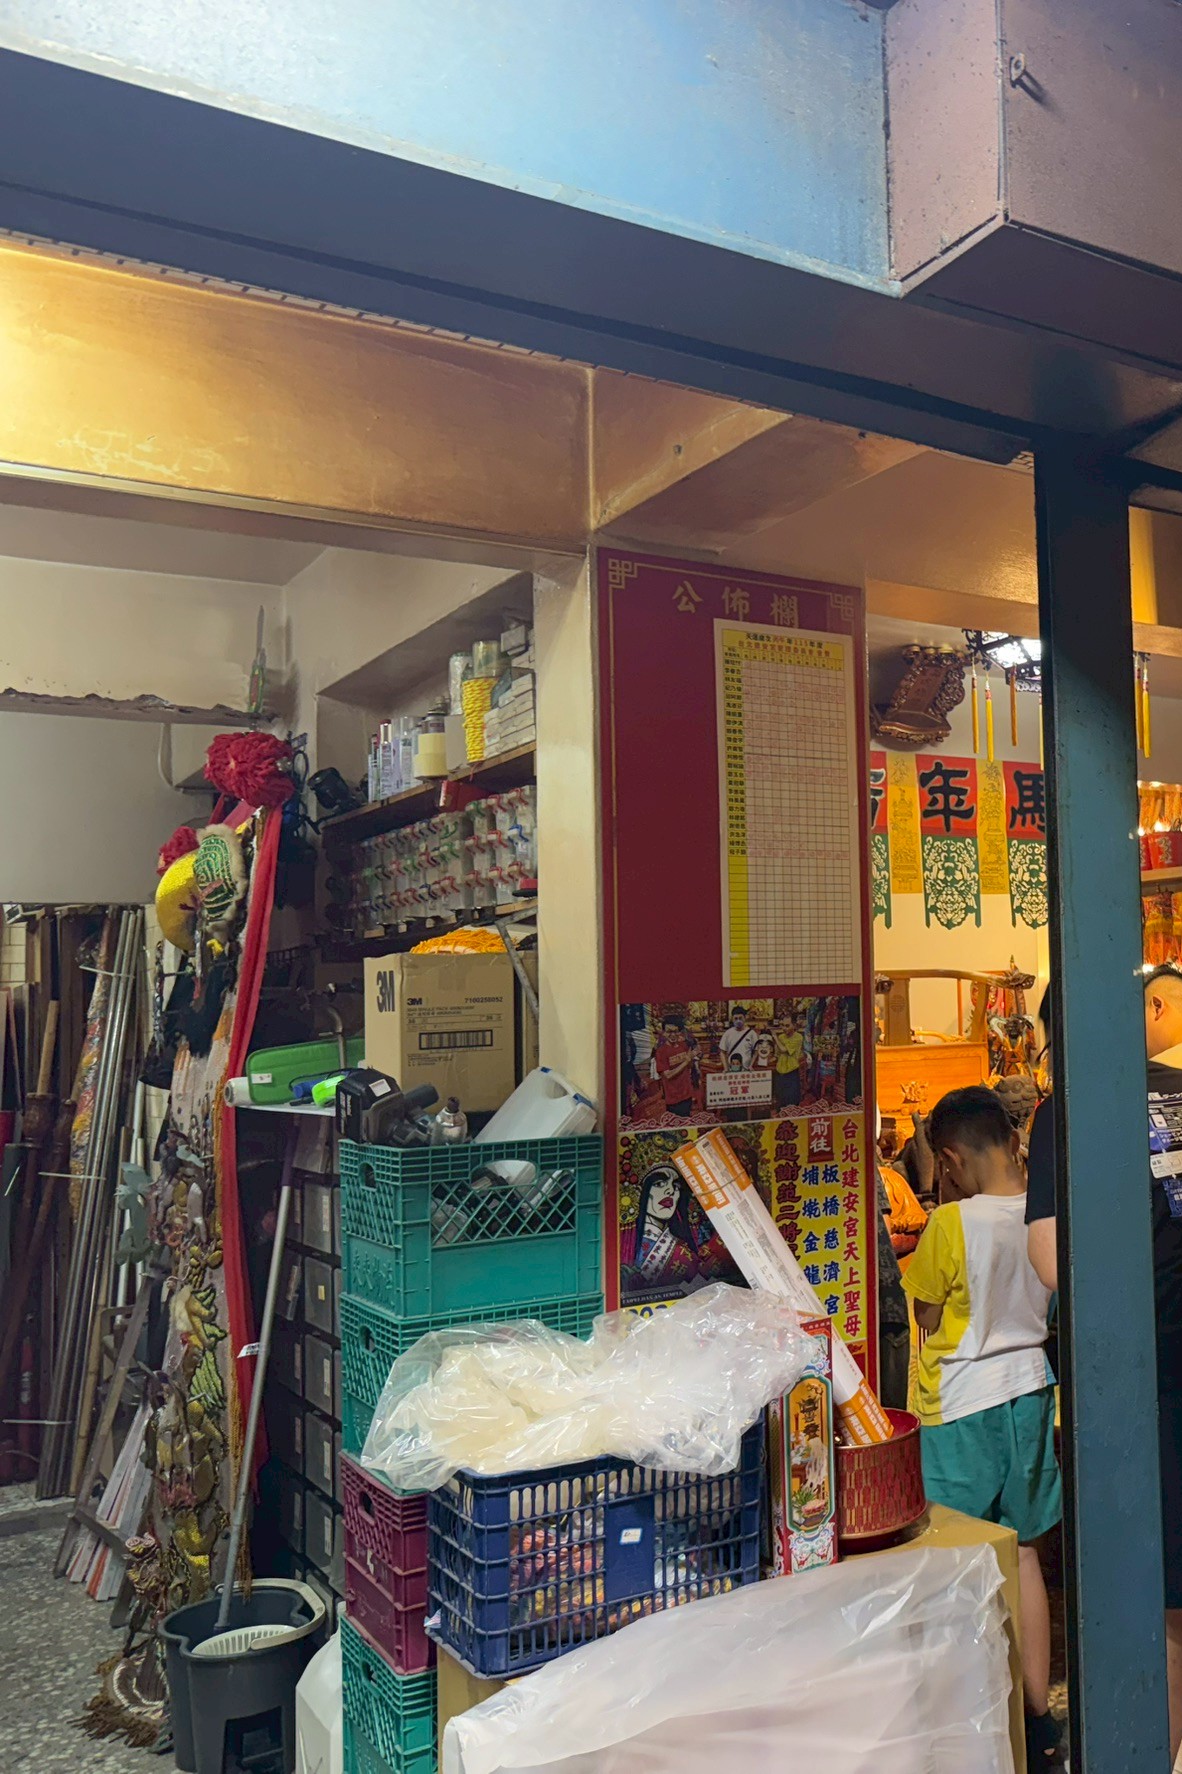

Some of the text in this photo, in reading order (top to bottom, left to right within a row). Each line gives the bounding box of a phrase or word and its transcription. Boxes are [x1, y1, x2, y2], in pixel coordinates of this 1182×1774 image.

[671, 579, 799, 629] 公佈欄
[376, 970, 395, 1013] 3M
[407, 997, 422, 1005] 3M
[809, 1117, 832, 1153] 前往
[775, 1120, 801, 1262] 恭迎謝范二將
[801, 1164, 822, 1300] 埔墘金龍
[841, 1119, 862, 1337] 台北建安宮天上聖母
